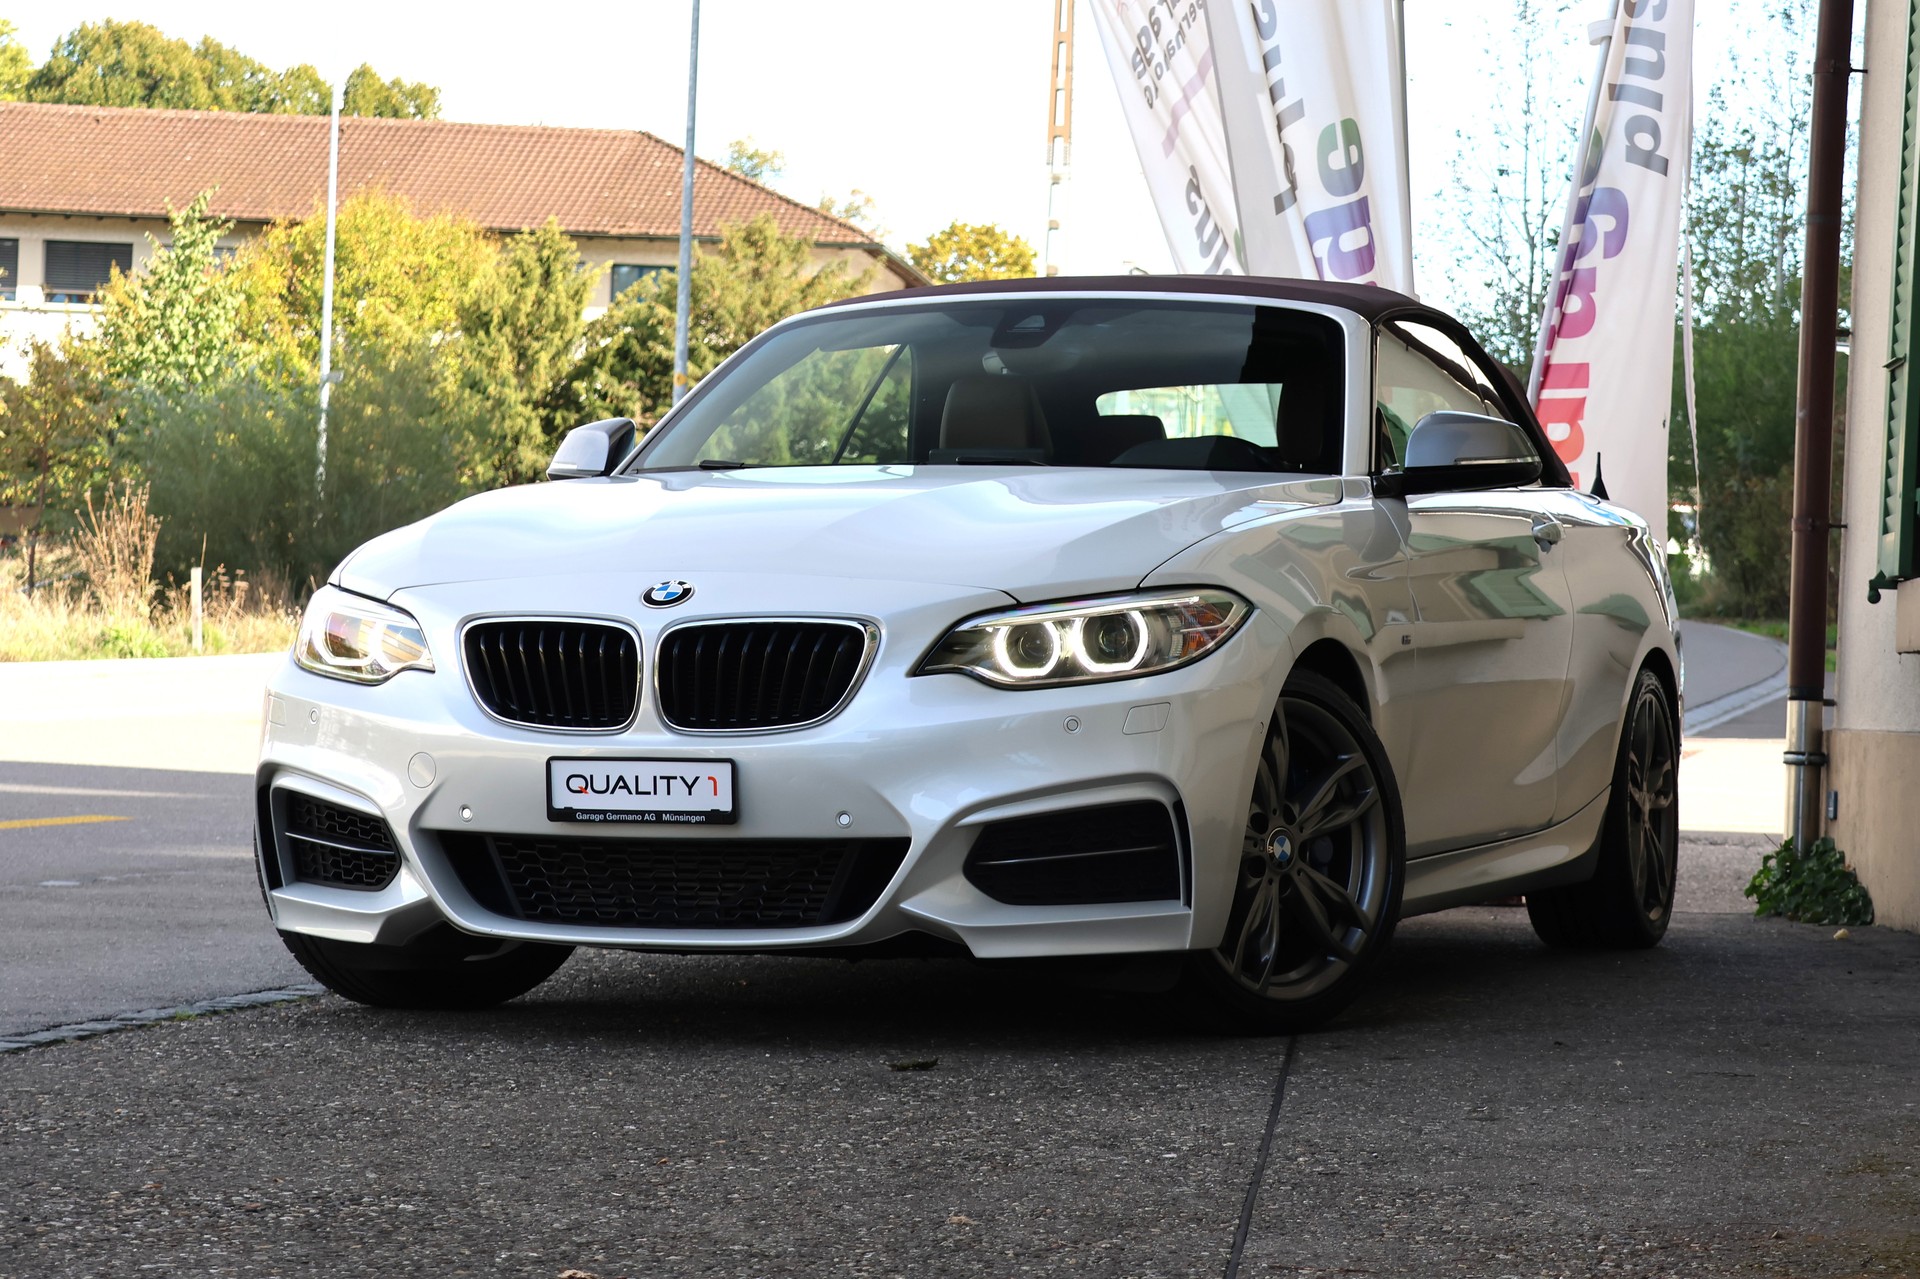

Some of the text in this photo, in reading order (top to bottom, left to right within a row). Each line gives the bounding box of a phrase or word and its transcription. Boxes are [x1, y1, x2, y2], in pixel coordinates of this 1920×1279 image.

[566, 773, 718, 797] QUALITY 1
[576, 812, 706, 823] Garage Germano AG Münsingen
